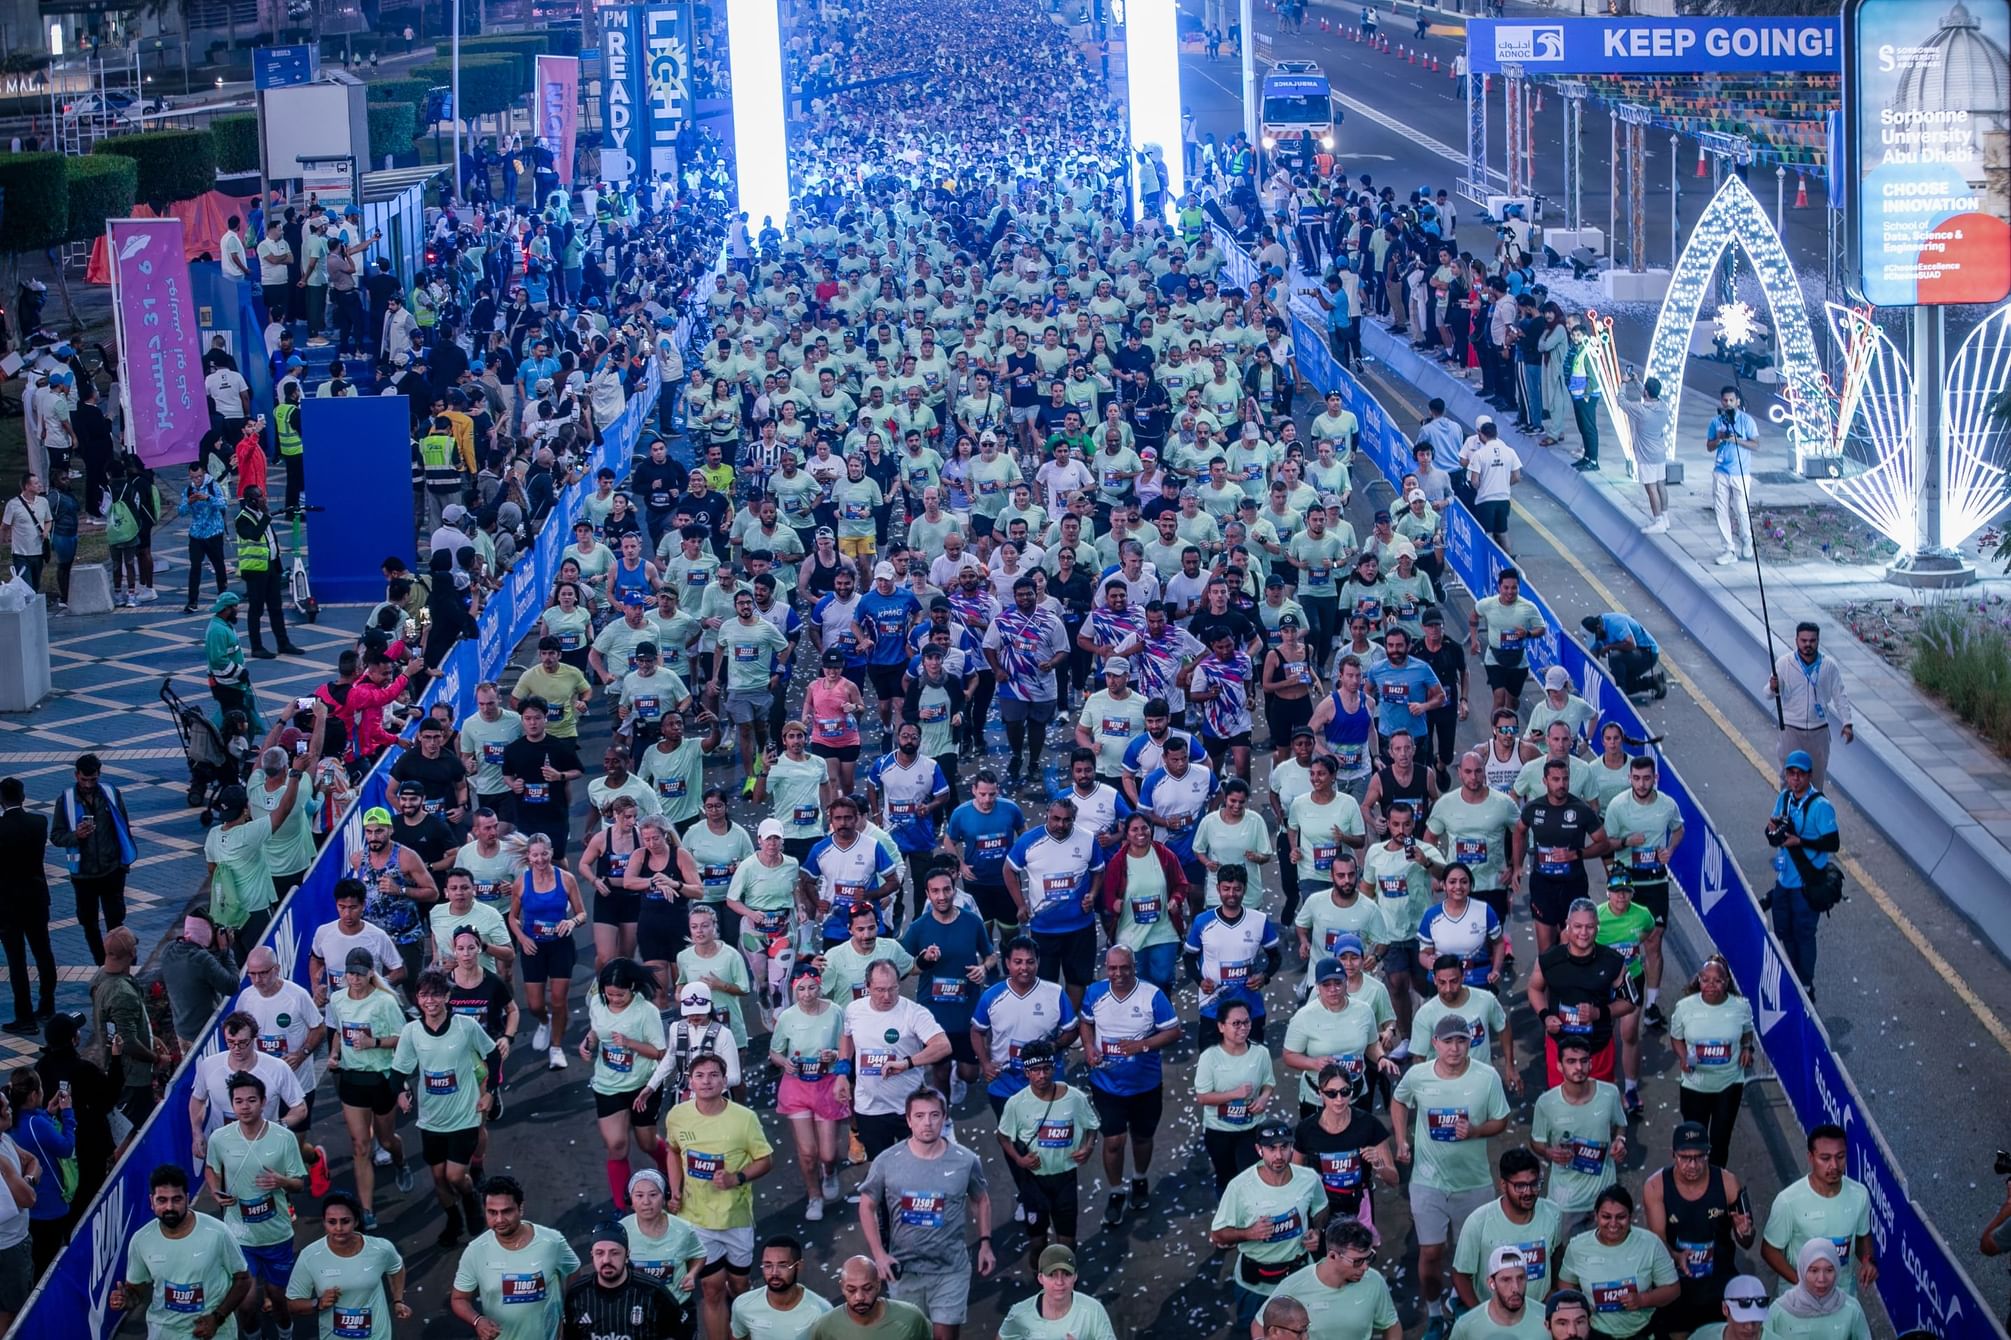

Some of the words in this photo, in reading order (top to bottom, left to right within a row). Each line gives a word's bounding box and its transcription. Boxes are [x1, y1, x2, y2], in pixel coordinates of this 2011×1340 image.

[1603, 28, 1695, 57] KEEP
[1705, 27, 1833, 57] GOING!
[1498, 51, 1531, 59] ADNOC
[608, 31, 632, 149] READY
[1880, 108, 1968, 125] Sorbonne
[1881, 128, 1972, 146] University
[1881, 147, 1917, 165] Abu
[1921, 146, 1974, 164] Dhabi
[1882, 181, 1950, 196] CHOOSE
[1883, 197, 1979, 213] INNOVATION
[1883, 221, 1917, 231] School
[1918, 220, 1929, 230] of
[1883, 232, 1911, 242] Data,
[1912, 230, 1954, 241] Science
[1955, 229, 1963, 239] &
[1883, 241, 1946, 253] Engineering
[142, 297, 159, 327] 31
[877, 608, 903, 619] KPMG
[1048, 1128, 1069, 1138] 14247
[1863, 1148, 1895, 1236] tadweer
[92, 1176, 124, 1290] RUN
[1871, 1207, 1887, 1258] oup
[173, 1290, 195, 1301] 13307
